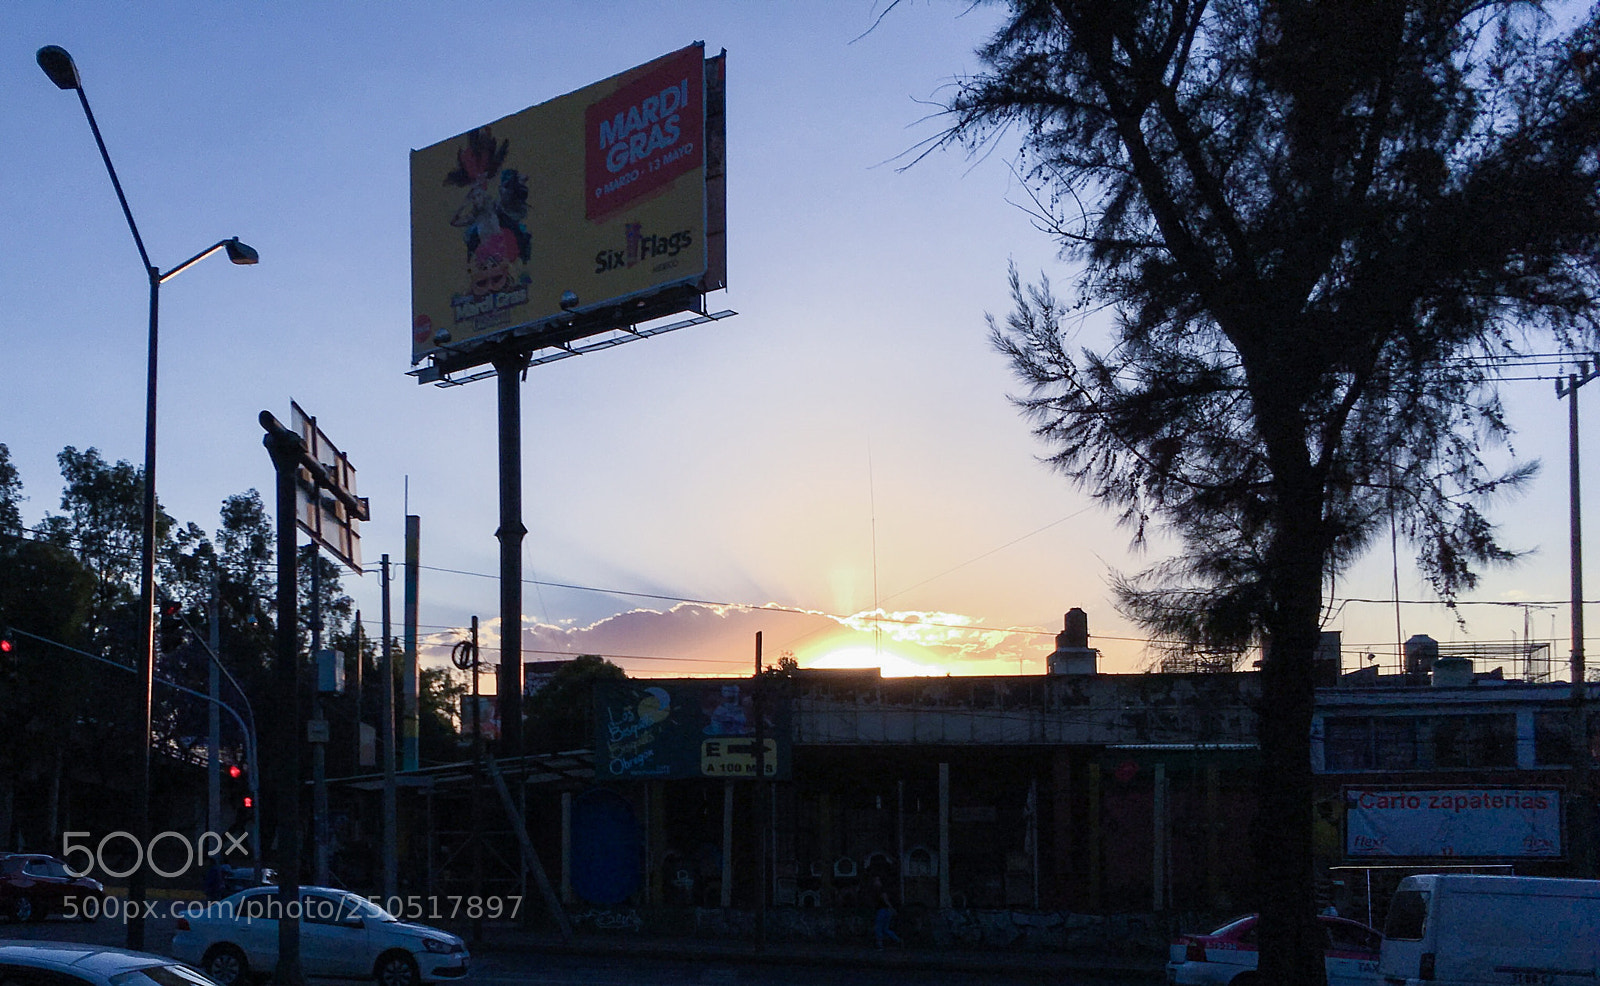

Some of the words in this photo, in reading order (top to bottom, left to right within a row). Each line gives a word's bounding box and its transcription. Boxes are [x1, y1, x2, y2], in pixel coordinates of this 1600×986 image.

[599, 78, 688, 150] MARDI
[606, 114, 681, 173] GRAS
[595, 187, 602, 198] 9
[603, 169, 640, 195] MARZO
[648, 158, 661, 172] 13
[662, 142, 694, 165] MAYO
[595, 249, 625, 274] Six
[640, 230, 692, 260] Flags
[706, 742, 721, 757] E
[706, 764, 716, 772] A
[719, 763, 741, 772] 100
[746, 763, 773, 773] MS
